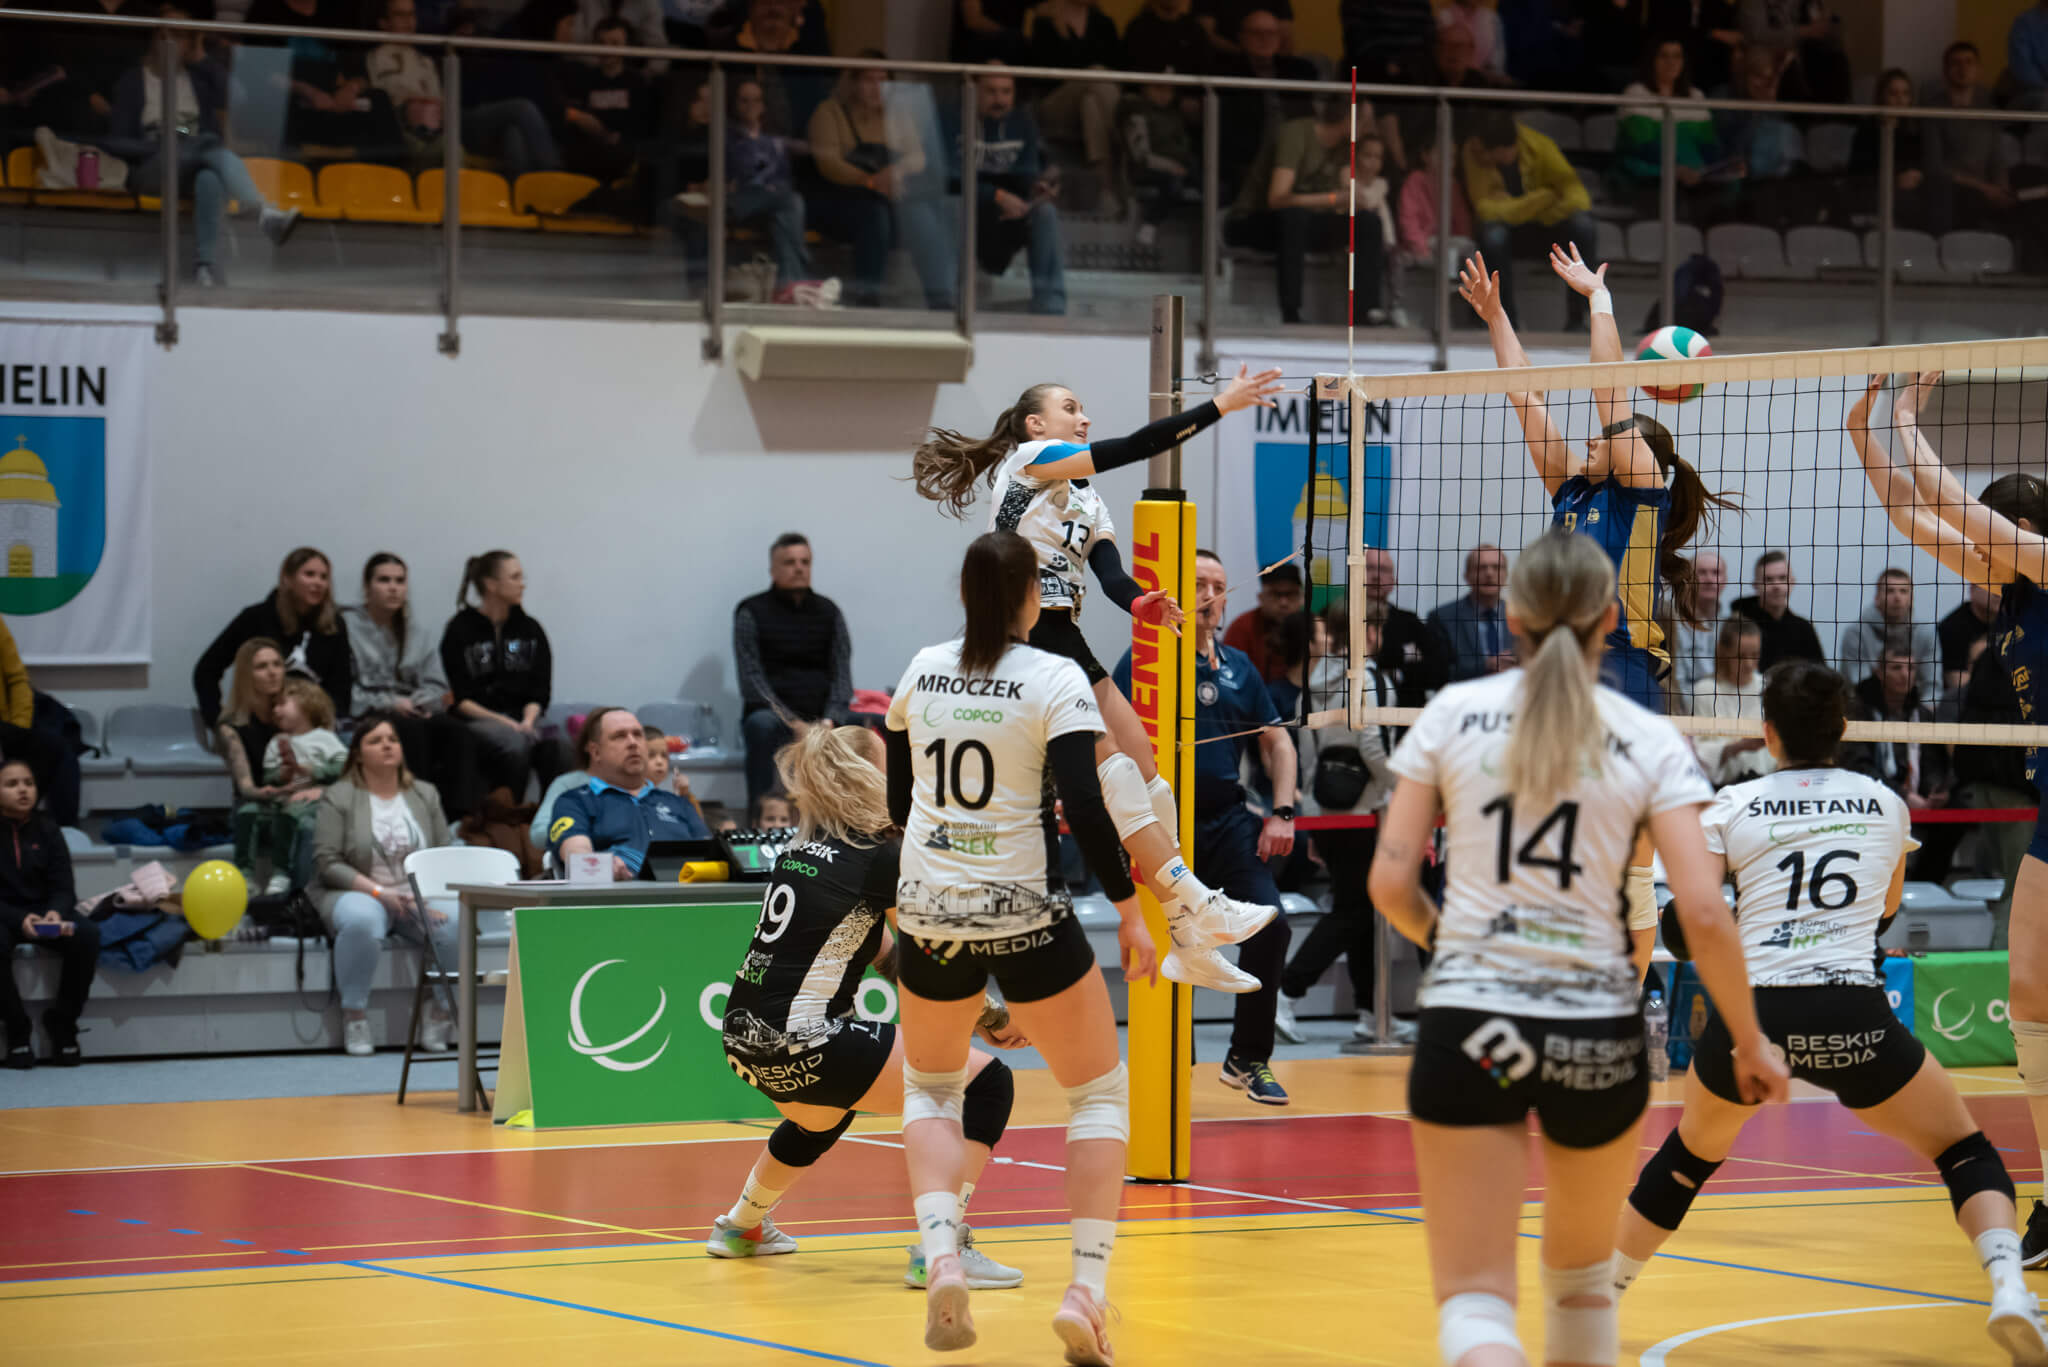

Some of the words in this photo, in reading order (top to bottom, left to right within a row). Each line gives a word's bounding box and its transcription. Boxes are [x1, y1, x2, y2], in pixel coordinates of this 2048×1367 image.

[1256, 398, 1391, 434] IMIELN
[917, 674, 1024, 700] MROCZEK
[953, 708, 1003, 724] COPCO
[924, 737, 994, 811] 10
[1749, 797, 1884, 817] ŚMIETANA
[1481, 793, 1582, 890] 14
[782, 859, 819, 877] COPCO
[1777, 849, 1860, 911] 16
[969, 931, 1054, 957] MEDIA
[1788, 1030, 1885, 1051] BESKID
[1789, 1048, 1877, 1069] MEDIA
